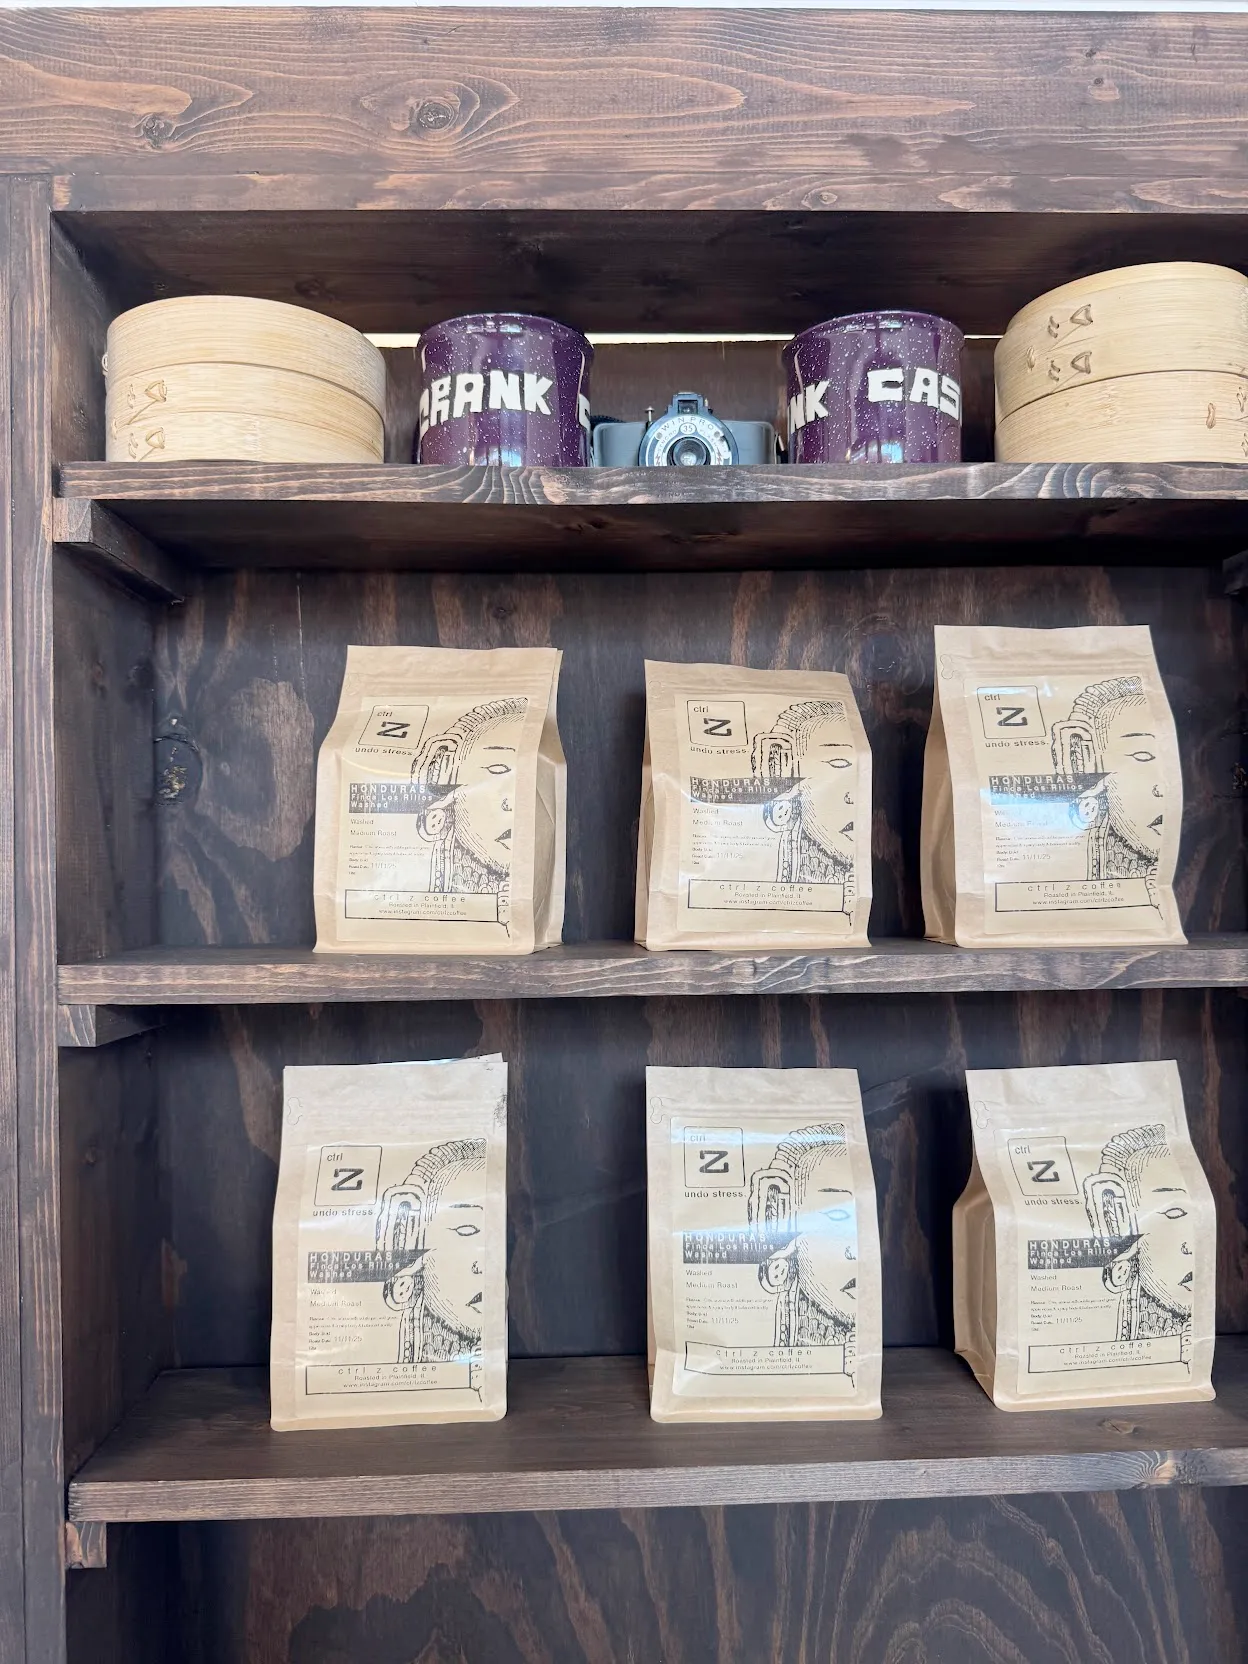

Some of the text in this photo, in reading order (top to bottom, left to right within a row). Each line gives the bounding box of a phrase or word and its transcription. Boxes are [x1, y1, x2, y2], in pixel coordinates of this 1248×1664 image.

[867, 367, 962, 428] CAS
[419, 370, 553, 438] CRANK
[996, 707, 1028, 727] Z
[377, 721, 411, 739] Z
[703, 717, 733, 737] Z
[985, 740, 1010, 748] undo
[690, 747, 713, 755] undo
[692, 778, 770, 787] HONDURAS
[991, 776, 1074, 785] HONDURAS
[351, 784, 426, 793] HONDURAS
[692, 791, 734, 800] Washed
[771, 884, 813, 893] coffee
[1082, 882, 1121, 890] coffee
[424, 895, 466, 903] coffee
[1015, 1145, 1030, 1154] ctrl
[326, 1153, 343, 1161] ctrl
[699, 1150, 729, 1173] Z
[1027, 1160, 1060, 1183] Z
[331, 1168, 364, 1191] Z
[1024, 1198, 1048, 1206] undo
[313, 1209, 338, 1217] undo
[685, 1233, 766, 1242] HONDURAS
[1029, 1239, 1110, 1249] HONDURAS
[310, 1252, 393, 1262] HONDURAS
[1030, 1257, 1072, 1265] Washed
[310, 1270, 352, 1278] Washed
[1110, 1341, 1152, 1350] coffee
[769, 1348, 813, 1356] coffee
[392, 1365, 437, 1373] coffee
